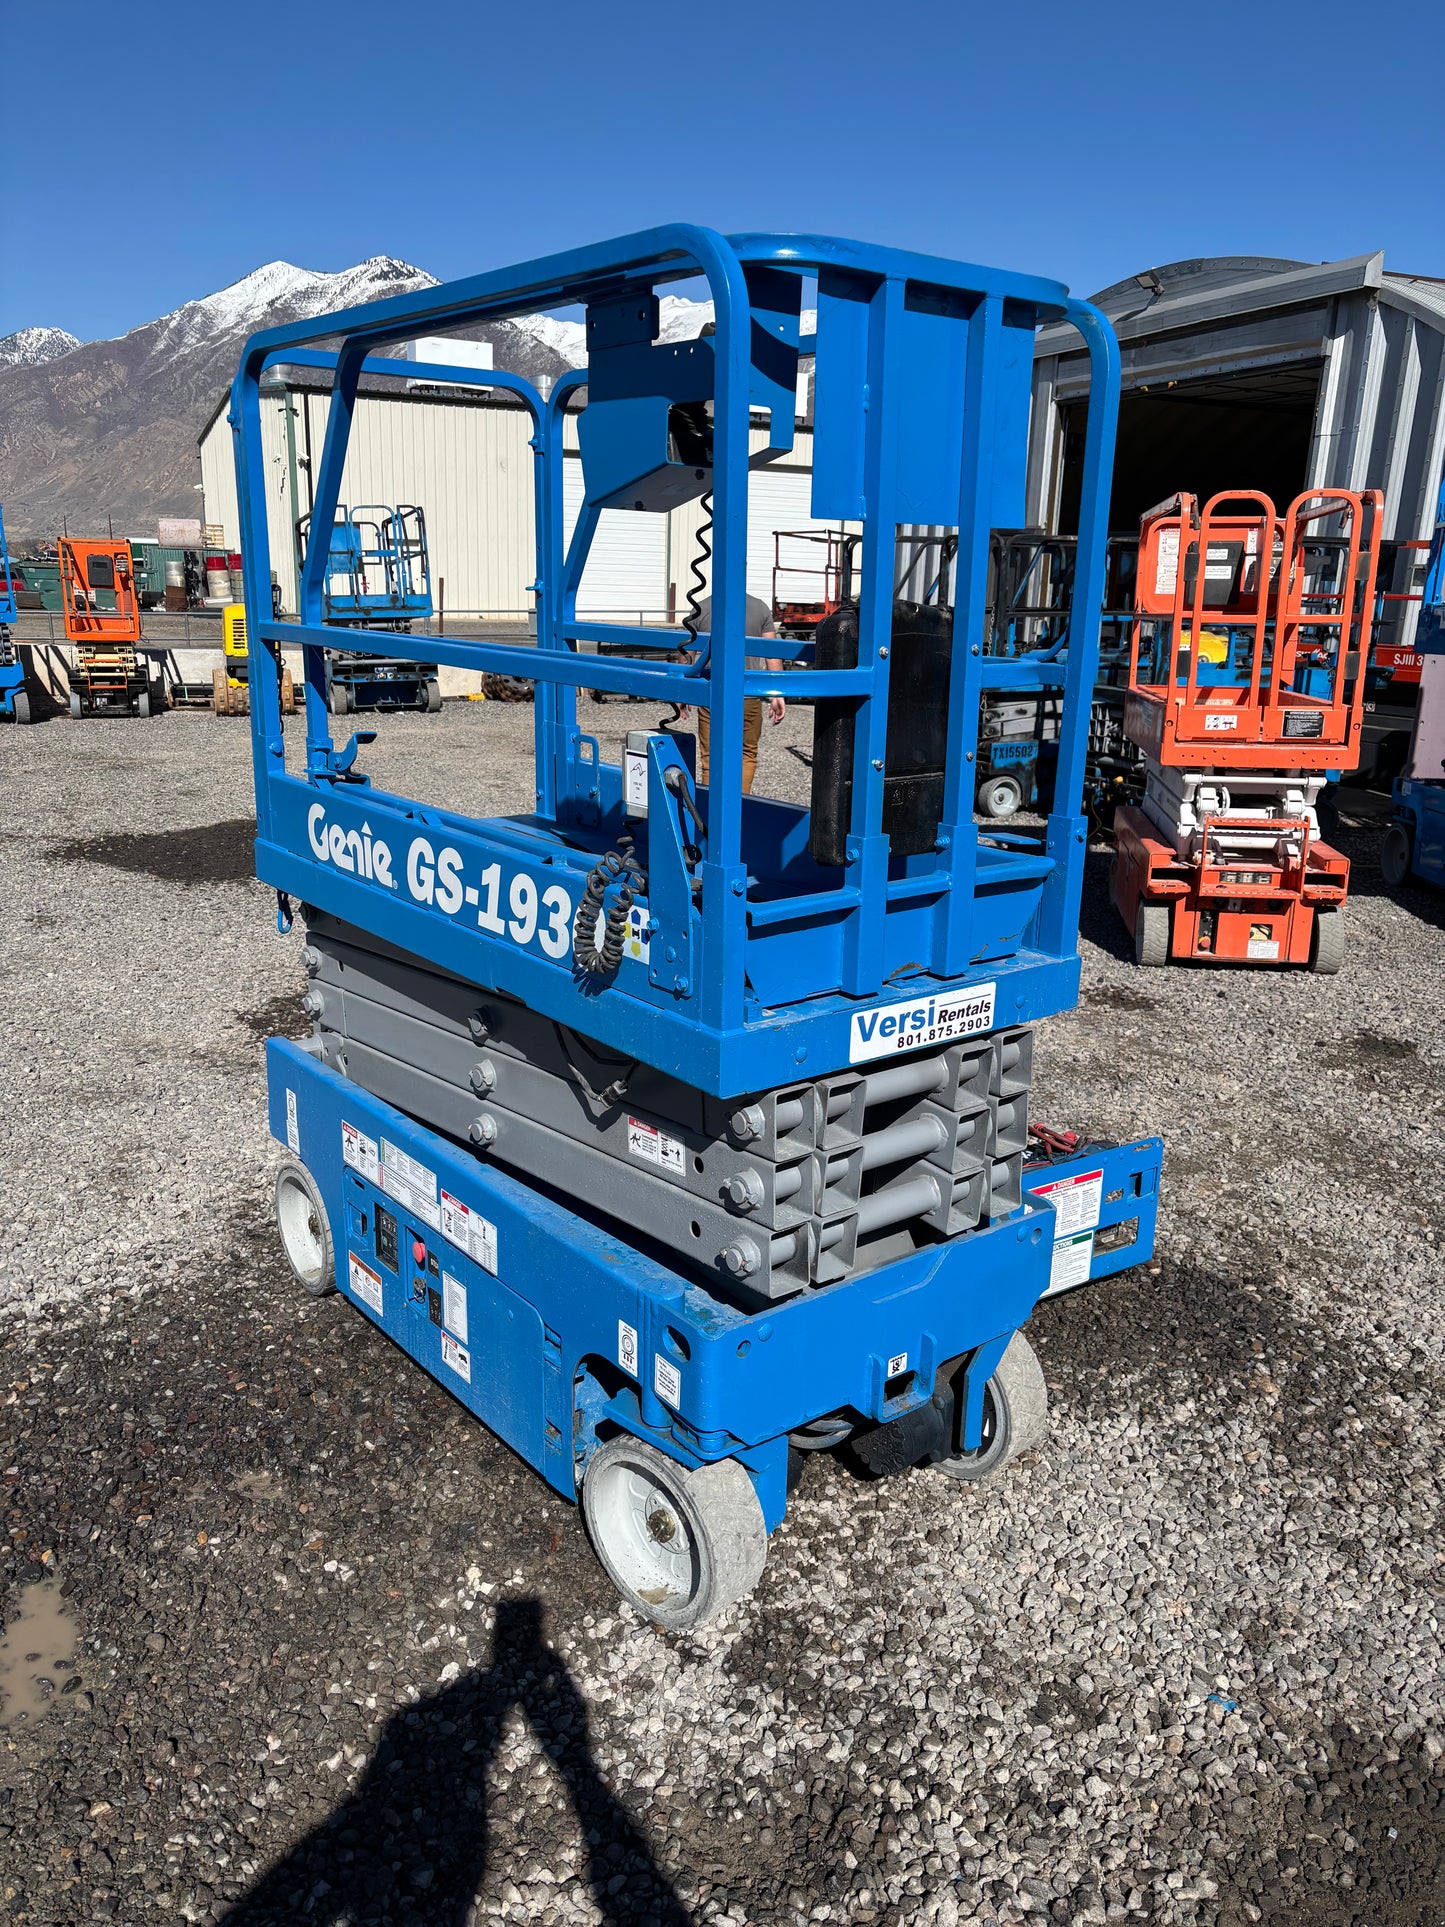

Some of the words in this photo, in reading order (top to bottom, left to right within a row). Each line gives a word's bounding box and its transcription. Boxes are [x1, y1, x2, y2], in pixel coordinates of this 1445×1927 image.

[857, 999, 936, 1043] Versi
[937, 999, 992, 1025] Rentals
[897, 1015, 991, 1049] 801.875.2903
